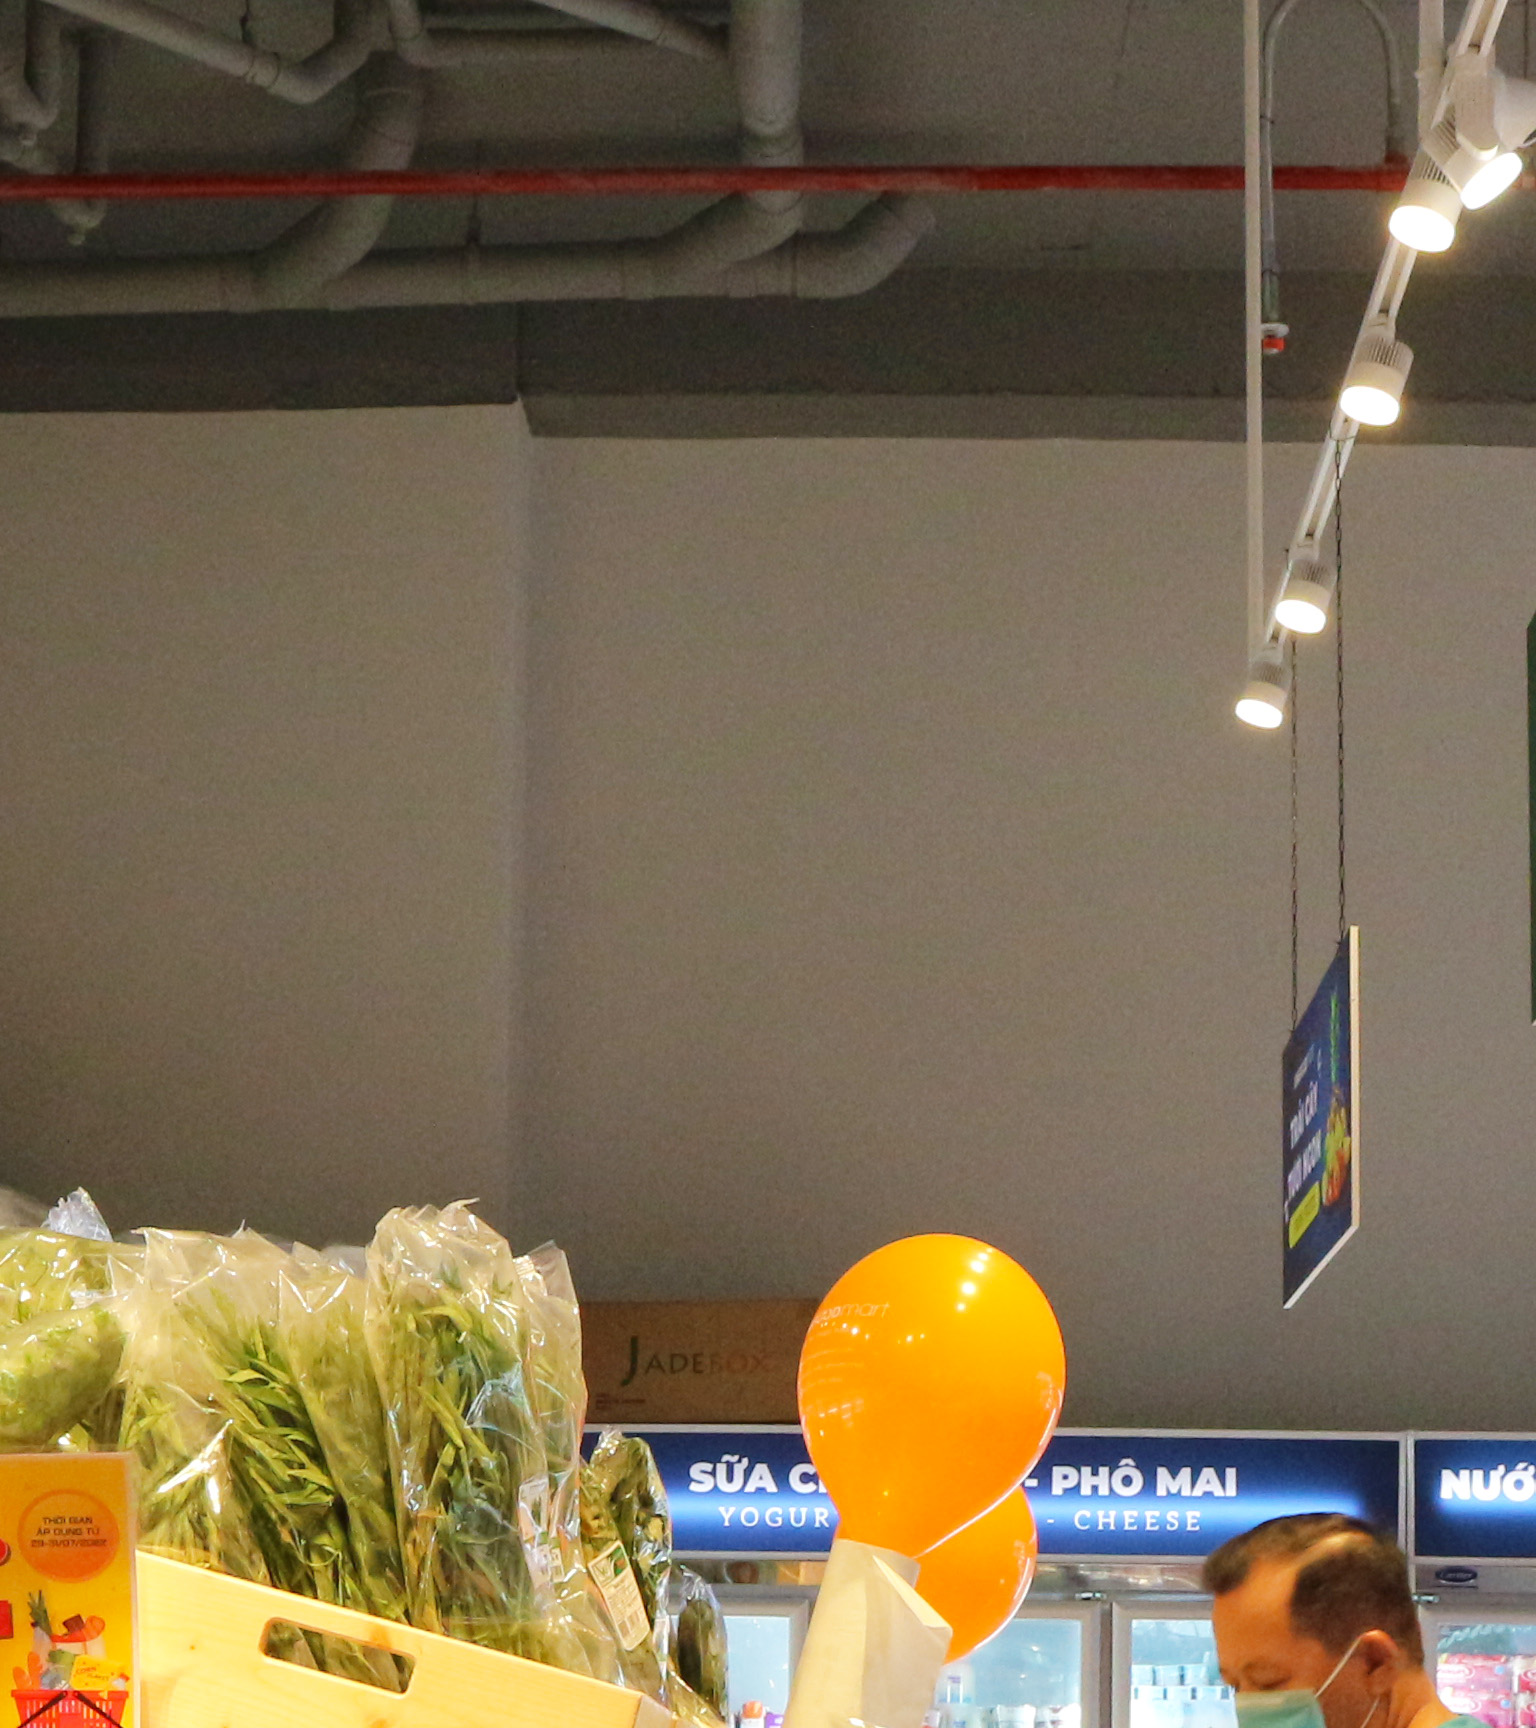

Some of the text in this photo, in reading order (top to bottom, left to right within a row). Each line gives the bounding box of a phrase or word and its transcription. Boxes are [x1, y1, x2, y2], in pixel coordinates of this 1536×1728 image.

[688, 1453, 1239, 1498] SỮA PHÔ MAI
[717, 1506, 1203, 1532] YOGUR CHEESE
